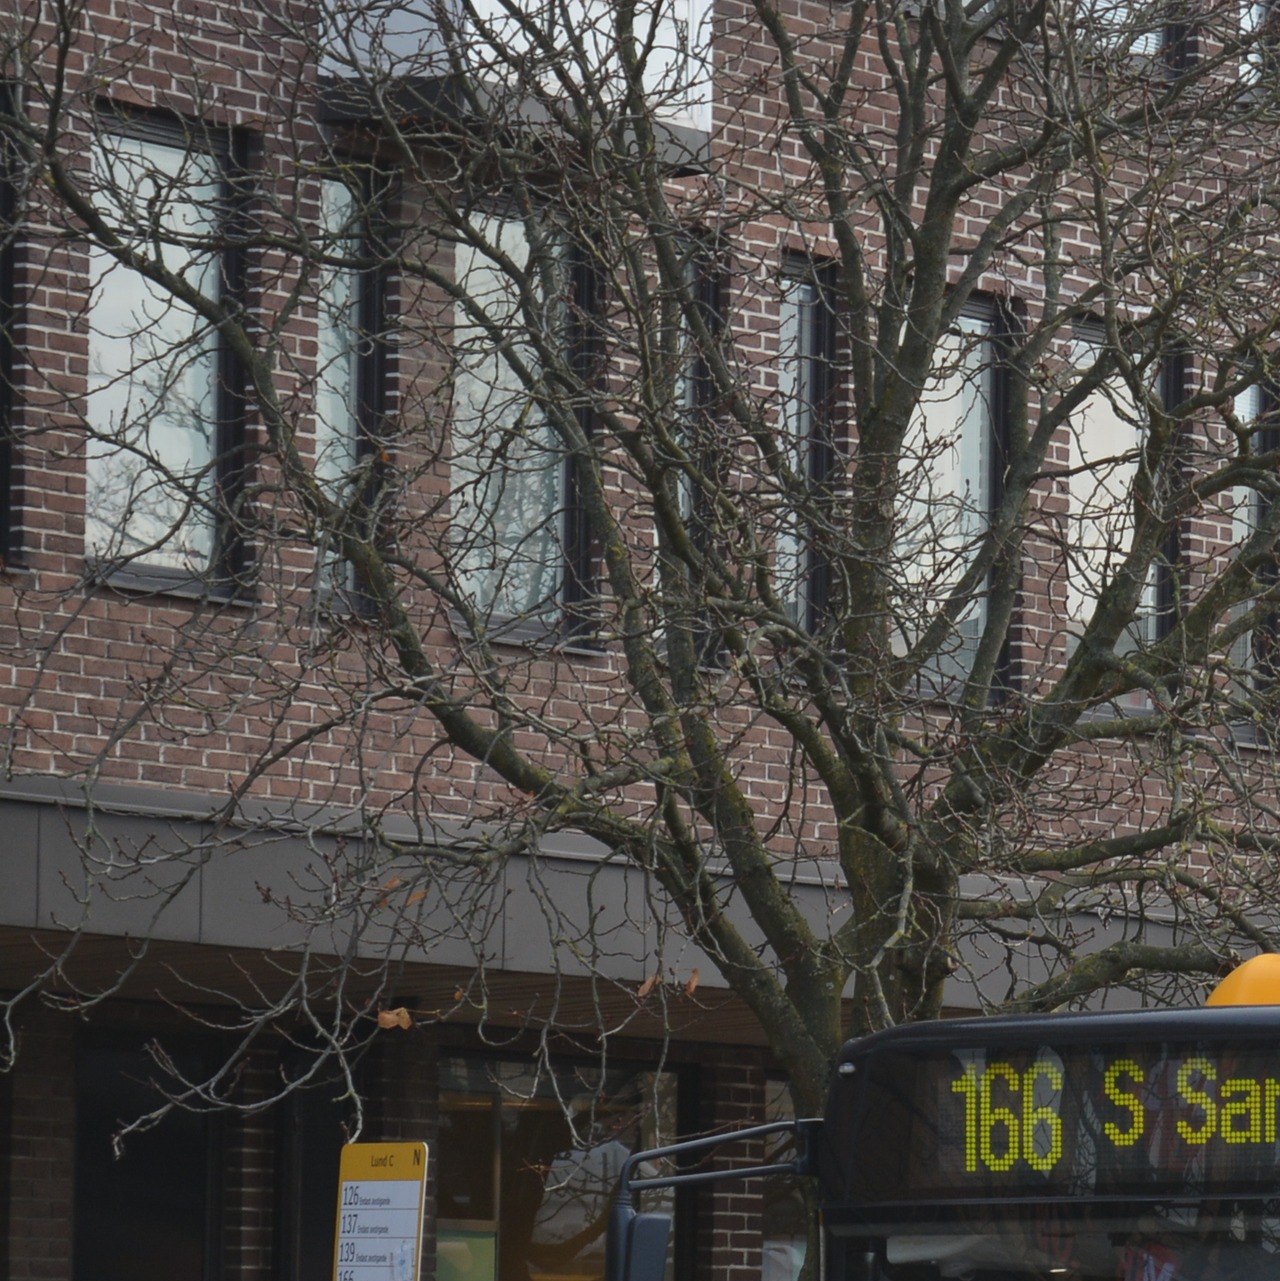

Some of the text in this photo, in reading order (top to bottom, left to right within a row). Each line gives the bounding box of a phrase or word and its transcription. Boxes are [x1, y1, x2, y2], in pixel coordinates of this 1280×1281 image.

[951, 1061, 1063, 1171] 166
[1104, 1058, 1144, 1146] S
[371, 1155, 394, 1167] Lund C
[412, 1149, 421, 1166] N
[343, 1186, 360, 1206] 126
[342, 1214, 358, 1233] 137
[339, 1242, 356, 1262] 139
